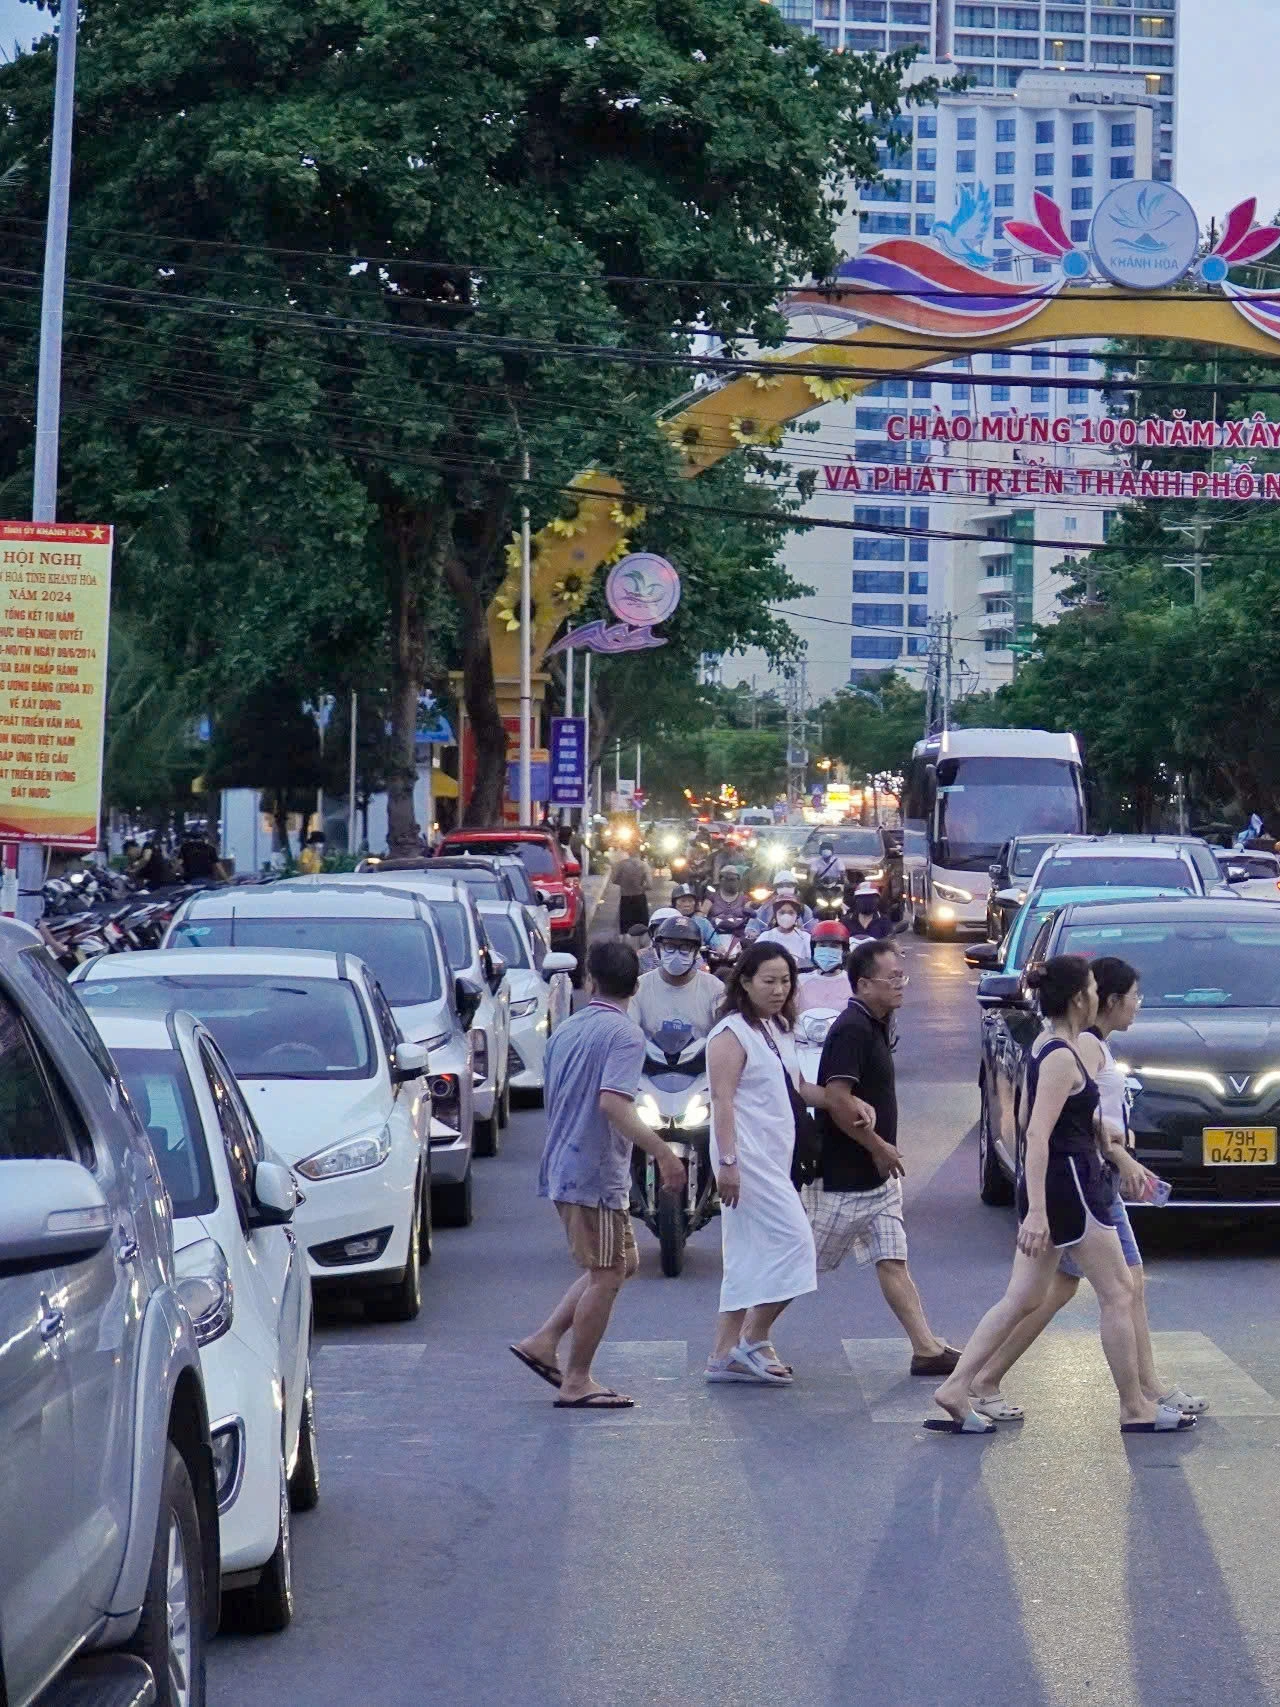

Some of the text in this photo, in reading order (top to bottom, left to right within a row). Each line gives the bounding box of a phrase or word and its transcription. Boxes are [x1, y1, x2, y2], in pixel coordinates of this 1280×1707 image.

[1110, 254, 1151, 270] KHÁNH
[886, 405, 974, 443] CHÀO
[980, 409, 1071, 443] MỪNG
[1080, 418, 1135, 444] 100
[1144, 410, 1216, 446] NĂM
[824, 454, 864, 492] VÀ
[873, 456, 953, 493] PHÁT
[966, 456, 1064, 495] TRIỂN
[1076, 458, 1183, 498] THÀNH
[1191, 456, 1257, 500] PHỐ
[3, 548, 82, 570] HỘI NGHỊ
[41, 590, 72, 602] 2024
[1225, 1131, 1255, 1146] 79H
[1211, 1148, 1268, 1163] 043.73
